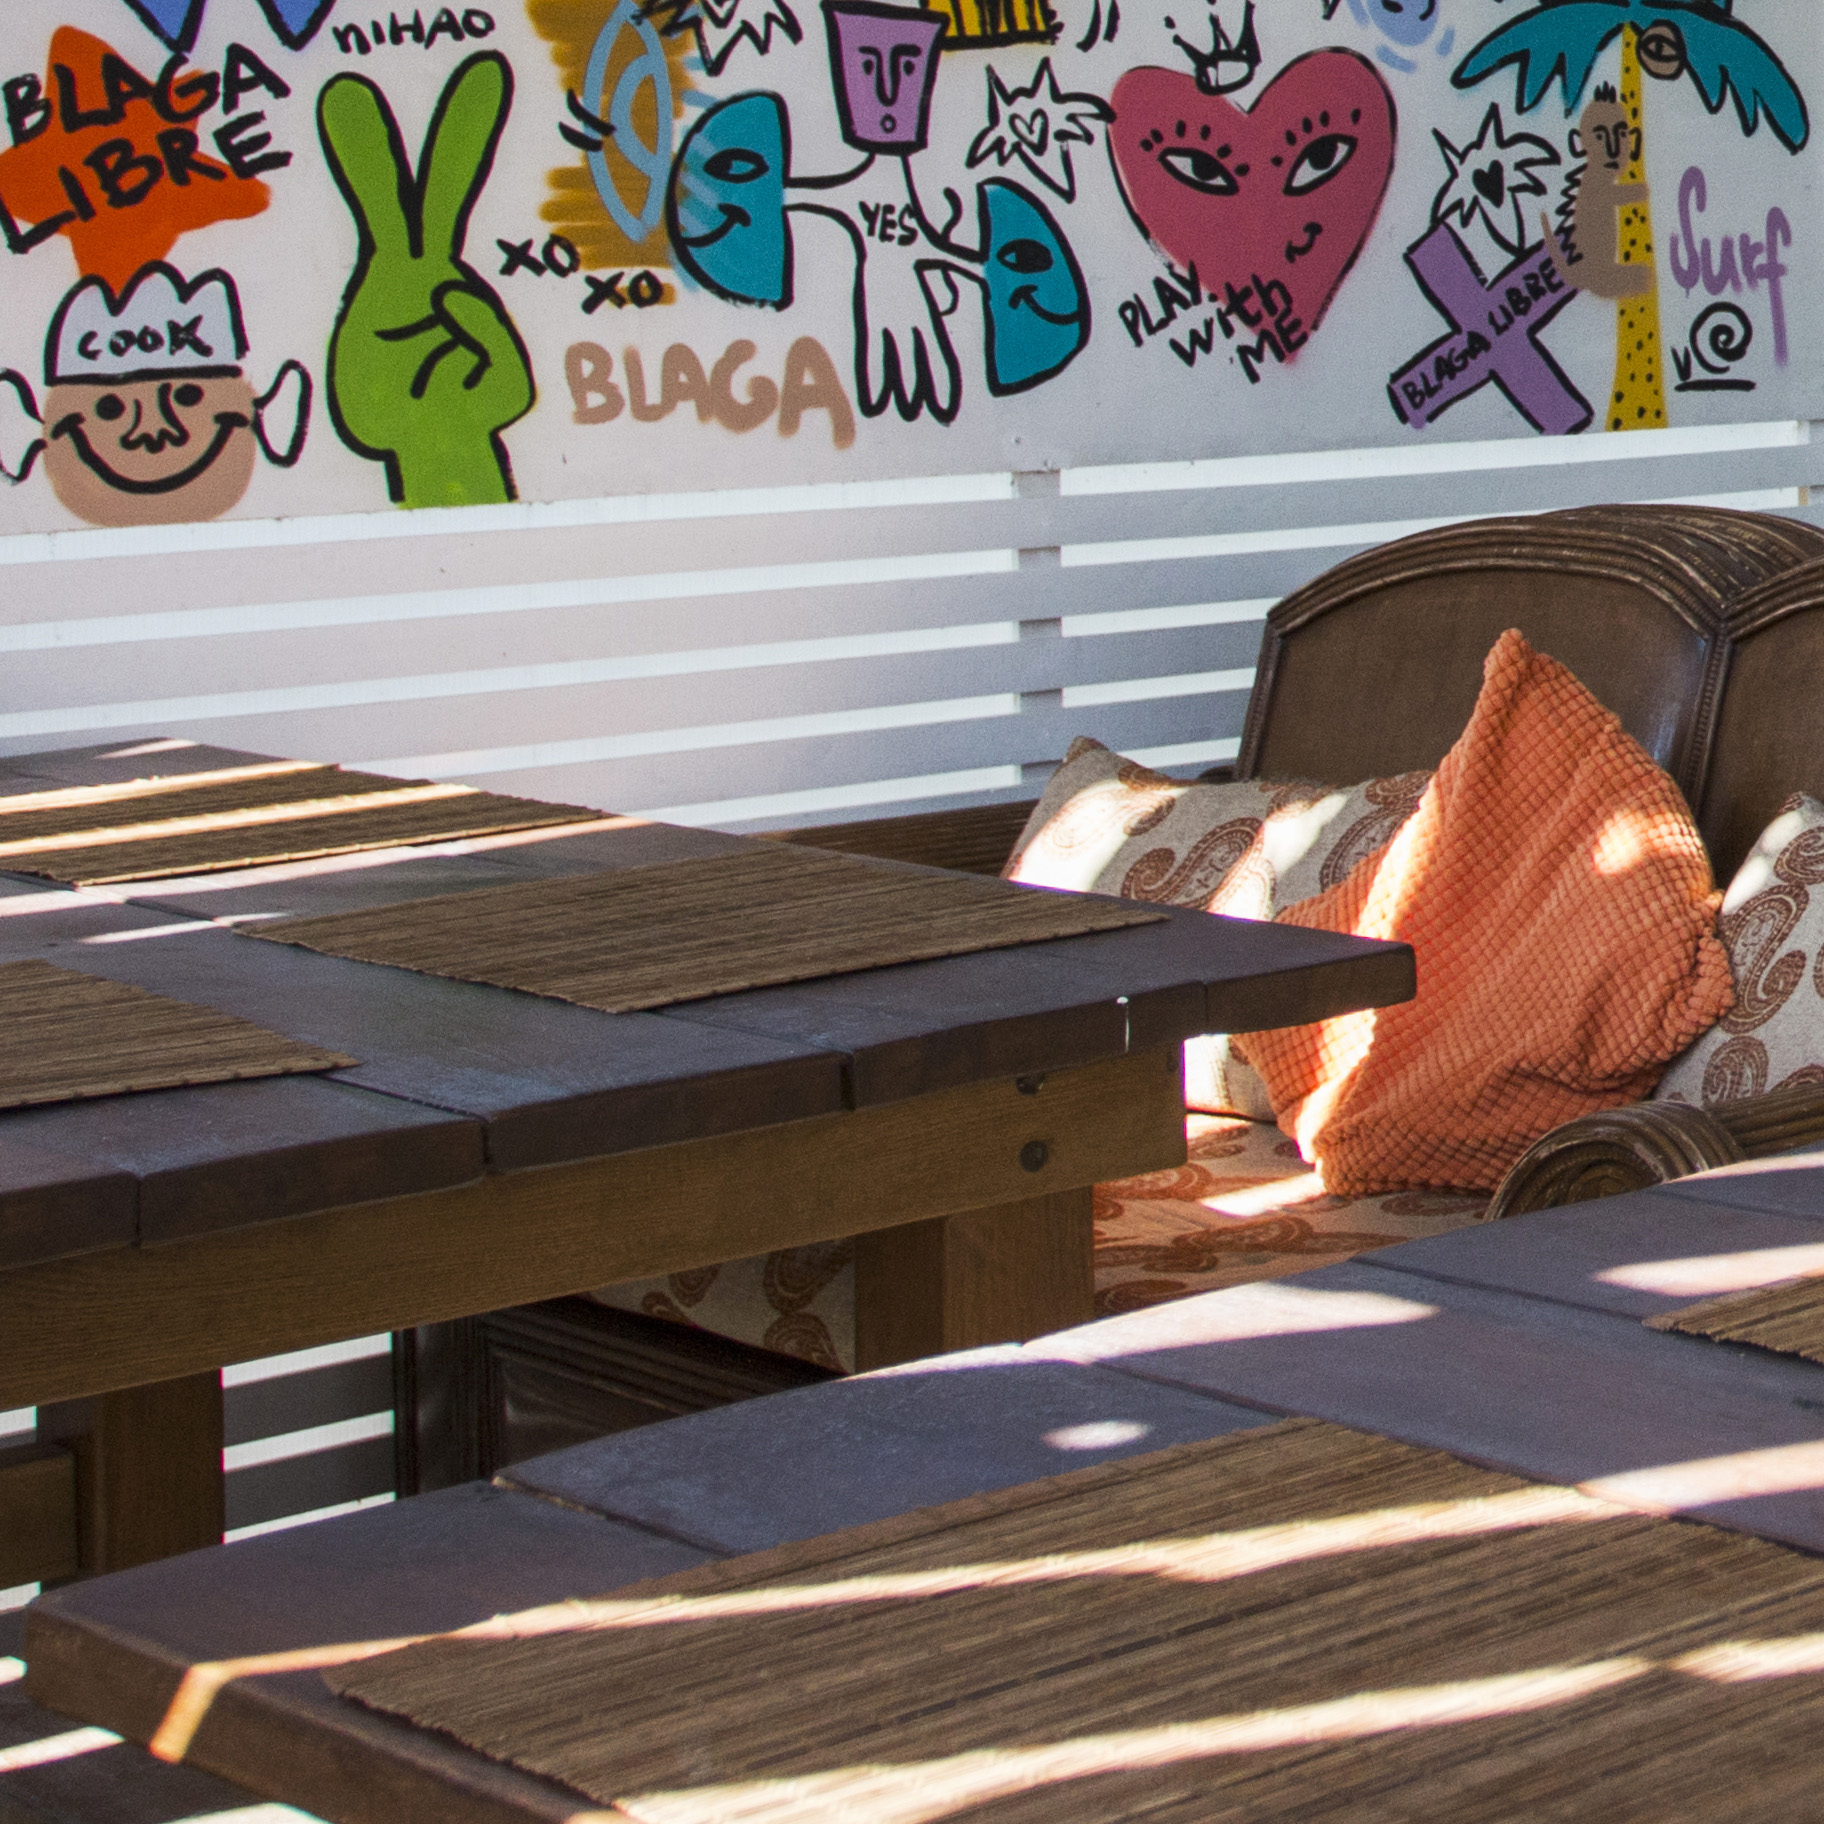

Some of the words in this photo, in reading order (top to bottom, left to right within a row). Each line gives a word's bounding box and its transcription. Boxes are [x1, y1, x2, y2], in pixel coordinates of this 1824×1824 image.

[1, 42, 290, 144] BLAGA
[858, 200, 920, 246] YES
[563, 335, 858, 452] BLAGA
